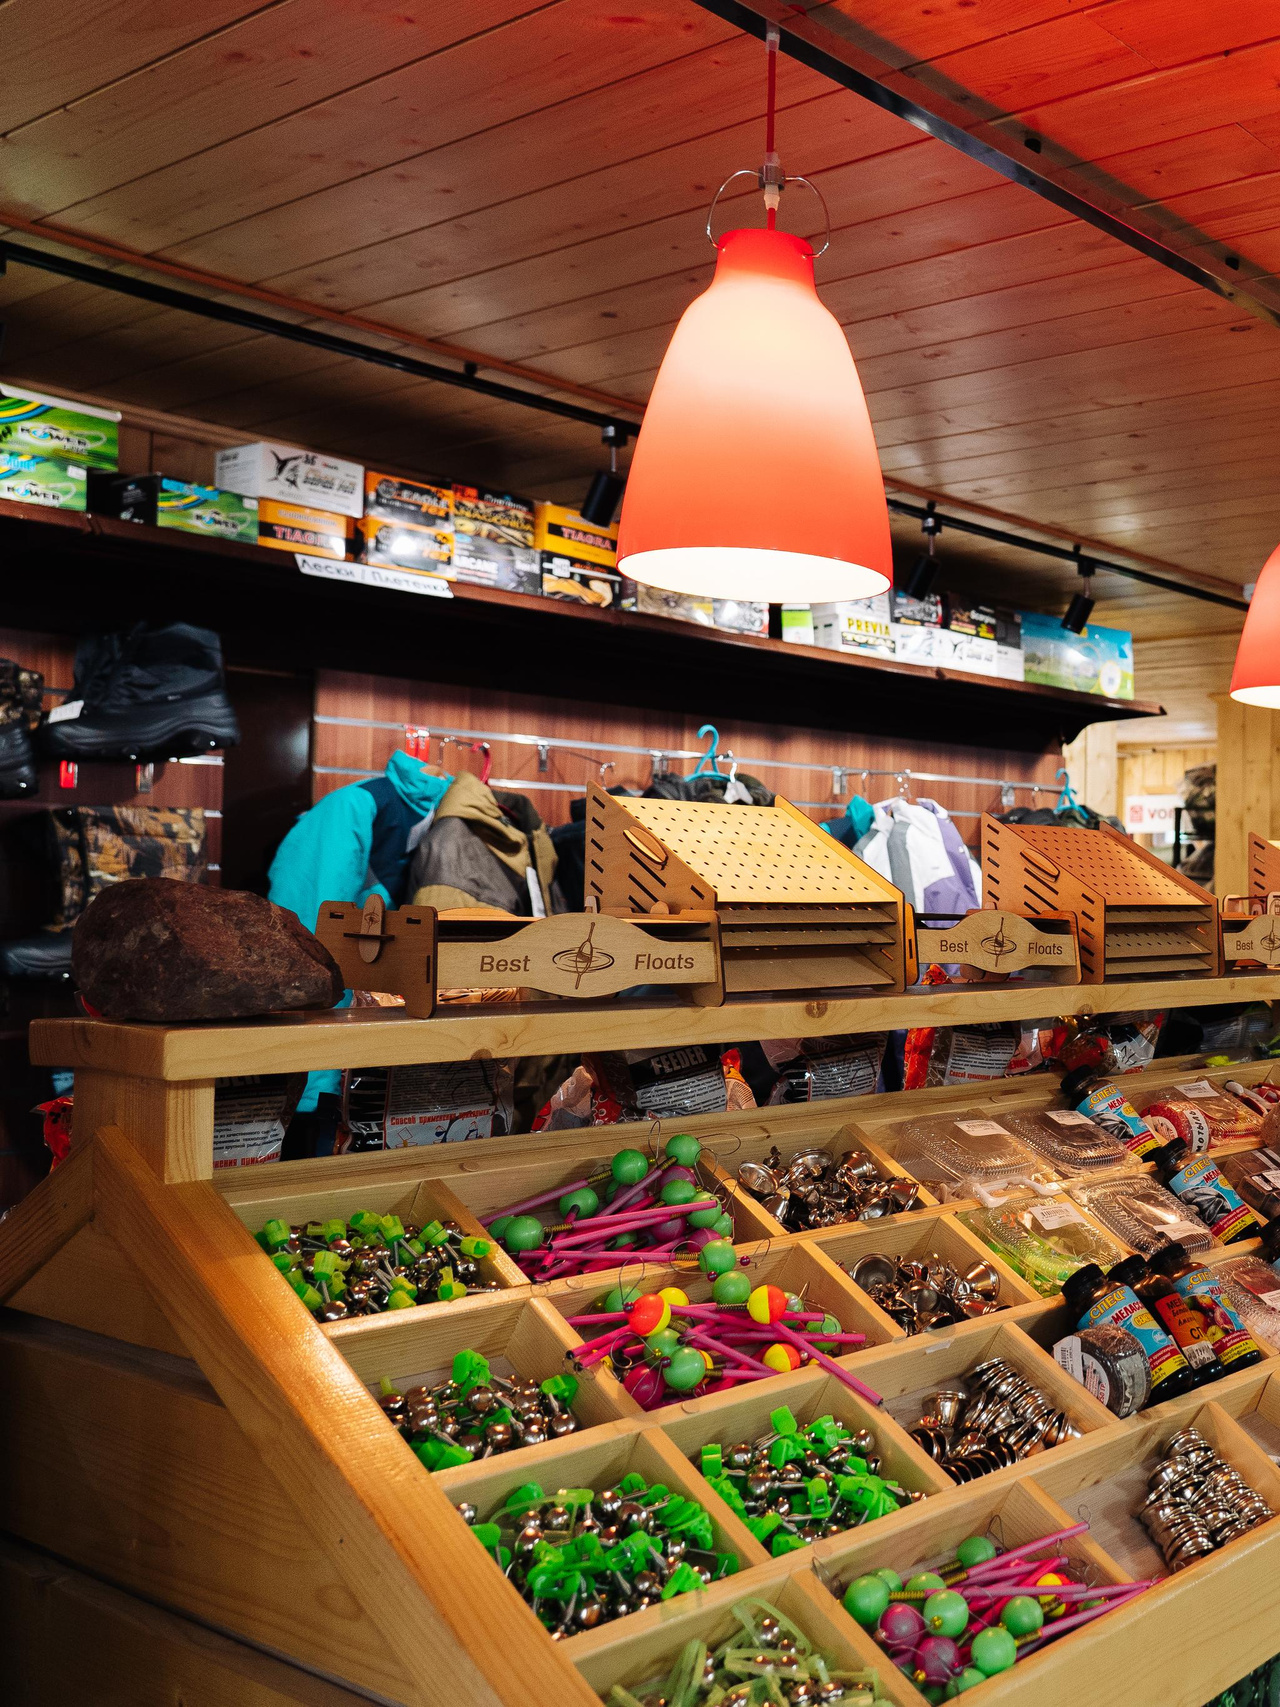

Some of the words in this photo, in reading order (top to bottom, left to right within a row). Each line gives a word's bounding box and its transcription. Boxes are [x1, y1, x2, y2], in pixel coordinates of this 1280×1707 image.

[561, 526, 613, 551] TIAGRA
[301, 558, 355, 578] Лески
[847, 617, 892, 637] PREVIA
[938, 938, 969, 954] Best
[1027, 940, 1064, 957] Floats
[1234, 938, 1255, 952] Best
[479, 953, 531, 974] Best
[633, 952, 696, 972] Floats
[650, 1045, 709, 1076] FEEDER
[389, 1114, 417, 1126] Способ
